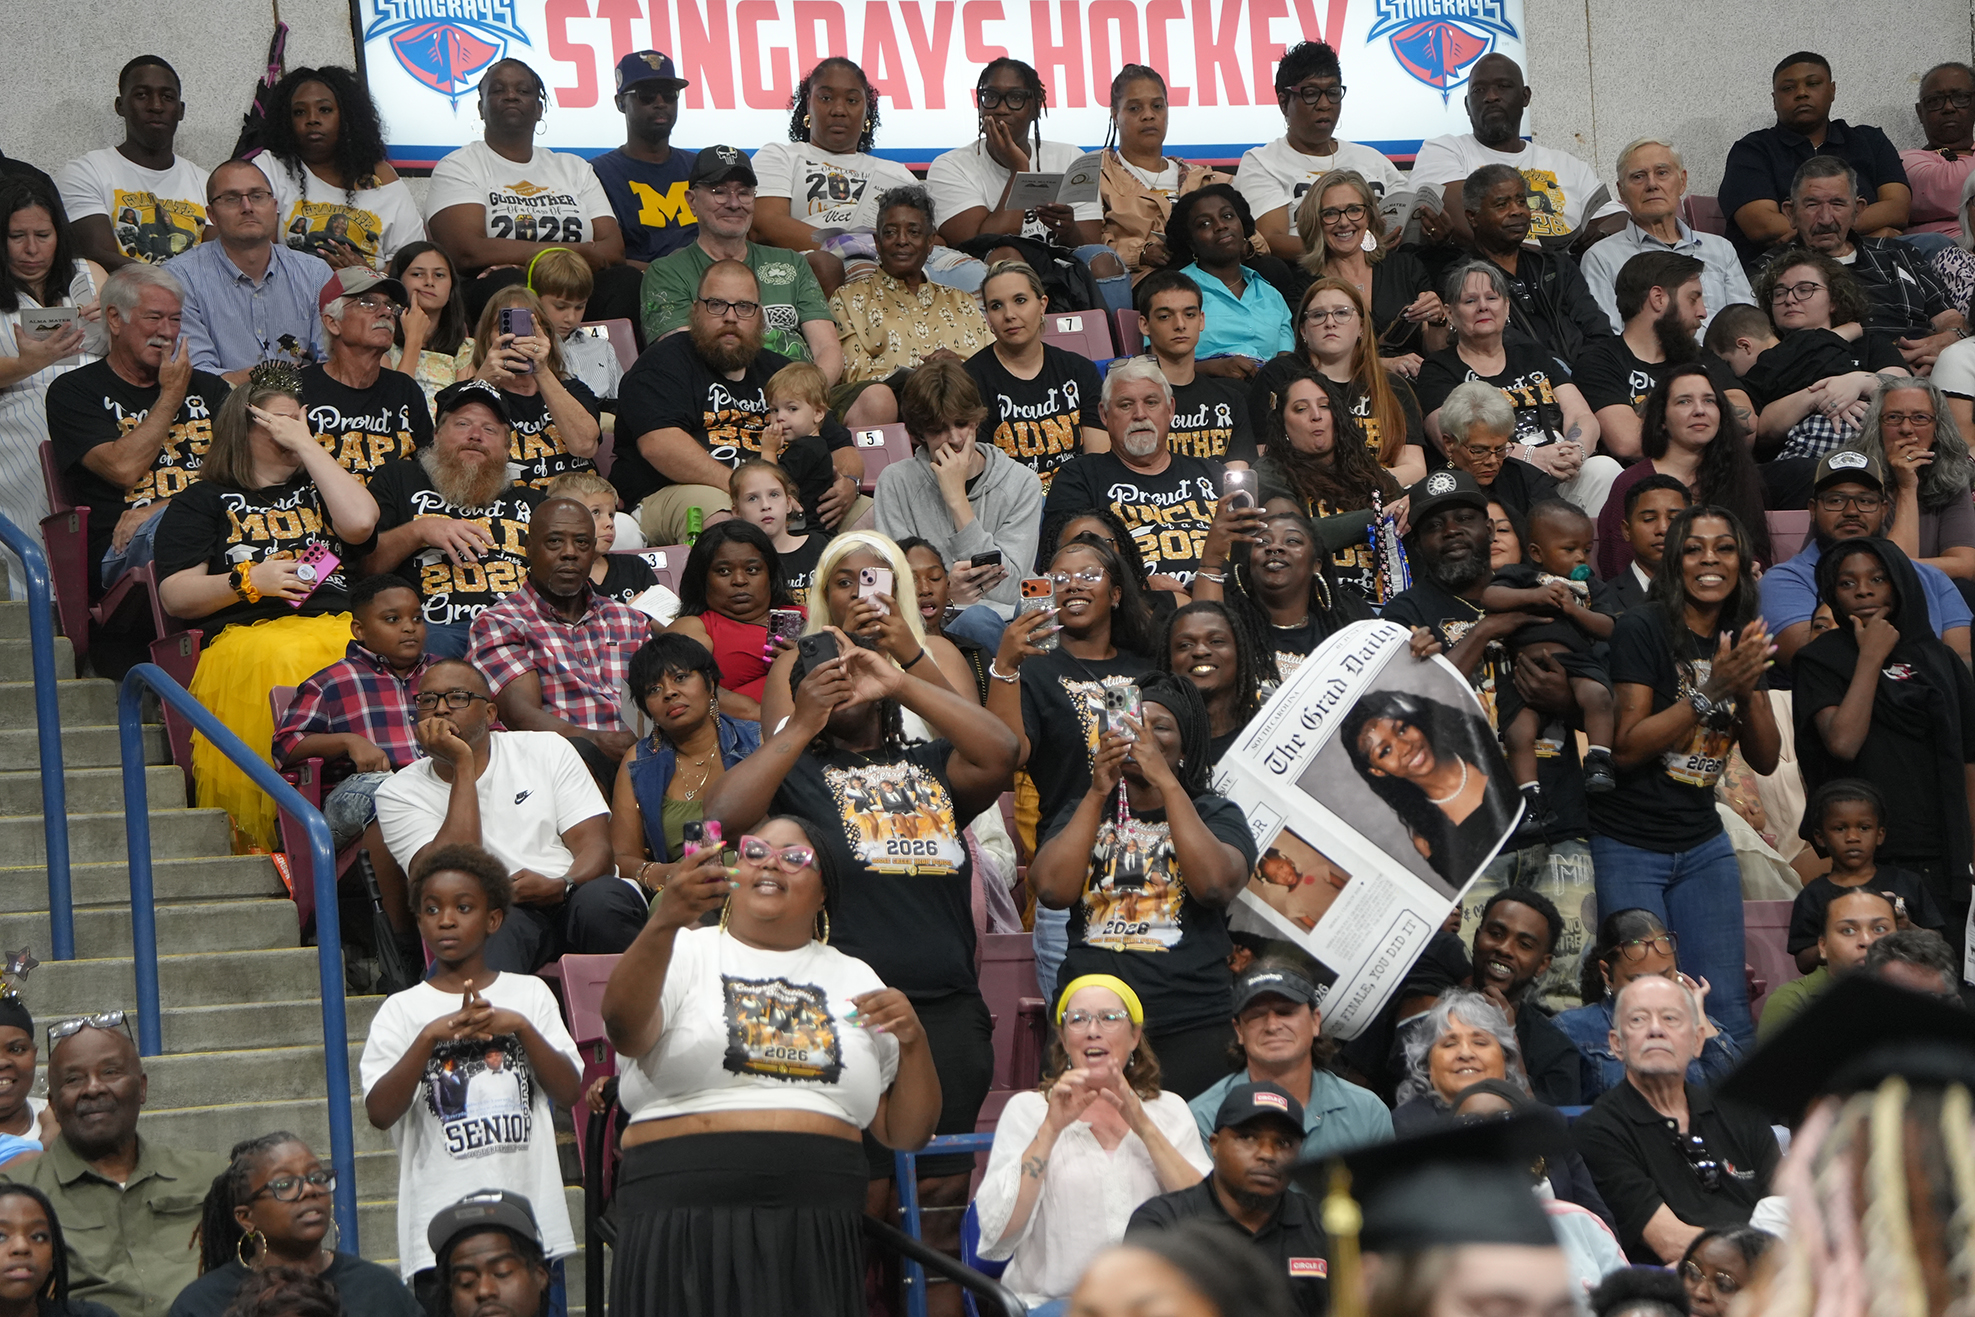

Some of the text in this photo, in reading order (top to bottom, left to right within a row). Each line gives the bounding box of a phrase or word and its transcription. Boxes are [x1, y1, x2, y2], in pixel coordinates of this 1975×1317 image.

[544, 0, 1348, 110] STINGRAYS HOCKEY
[122, 192, 196, 217] GRADATE
[489, 192, 577, 207] GODMOTHER
[628, 180, 698, 228] M
[491, 214, 583, 242] 2026
[591, 327, 599, 338] 4
[1065, 318, 1073, 331] 7
[706, 383, 770, 414] Proud
[997, 387, 1060, 421] Proud
[308, 404, 391, 434] Proud
[1171, 403, 1209, 429] oud
[866, 432, 875, 446] 5
[533, 457, 548, 477] of
[220, 486, 304, 515] Proud
[411, 490, 506, 516] Proud
[1107, 480, 1192, 506] Proud
[648, 553, 657, 568] 3
[1264, 732, 1306, 775] The
[1300, 678, 1348, 731] Grad
[1340, 625, 1399, 677] Daily
[1251, 723, 1273, 751] SOUTH
[1270, 690, 1300, 727] CAROLINA
[1686, 754, 1723, 773] 2026
[886, 839, 940, 857] 2026
[1102, 920, 1151, 936] 2026
[1340, 982, 1376, 1022] FINALE,
[1369, 957, 1390, 981] YOU
[1386, 935, 1406, 959] DID
[1402, 919, 1417, 936] IT
[764, 1045, 809, 1061] 2026
[515, 1044, 531, 1117] 2026
[445, 1114, 532, 1154] SENIOR
[1293, 1262, 1317, 1271] CIRCLE
